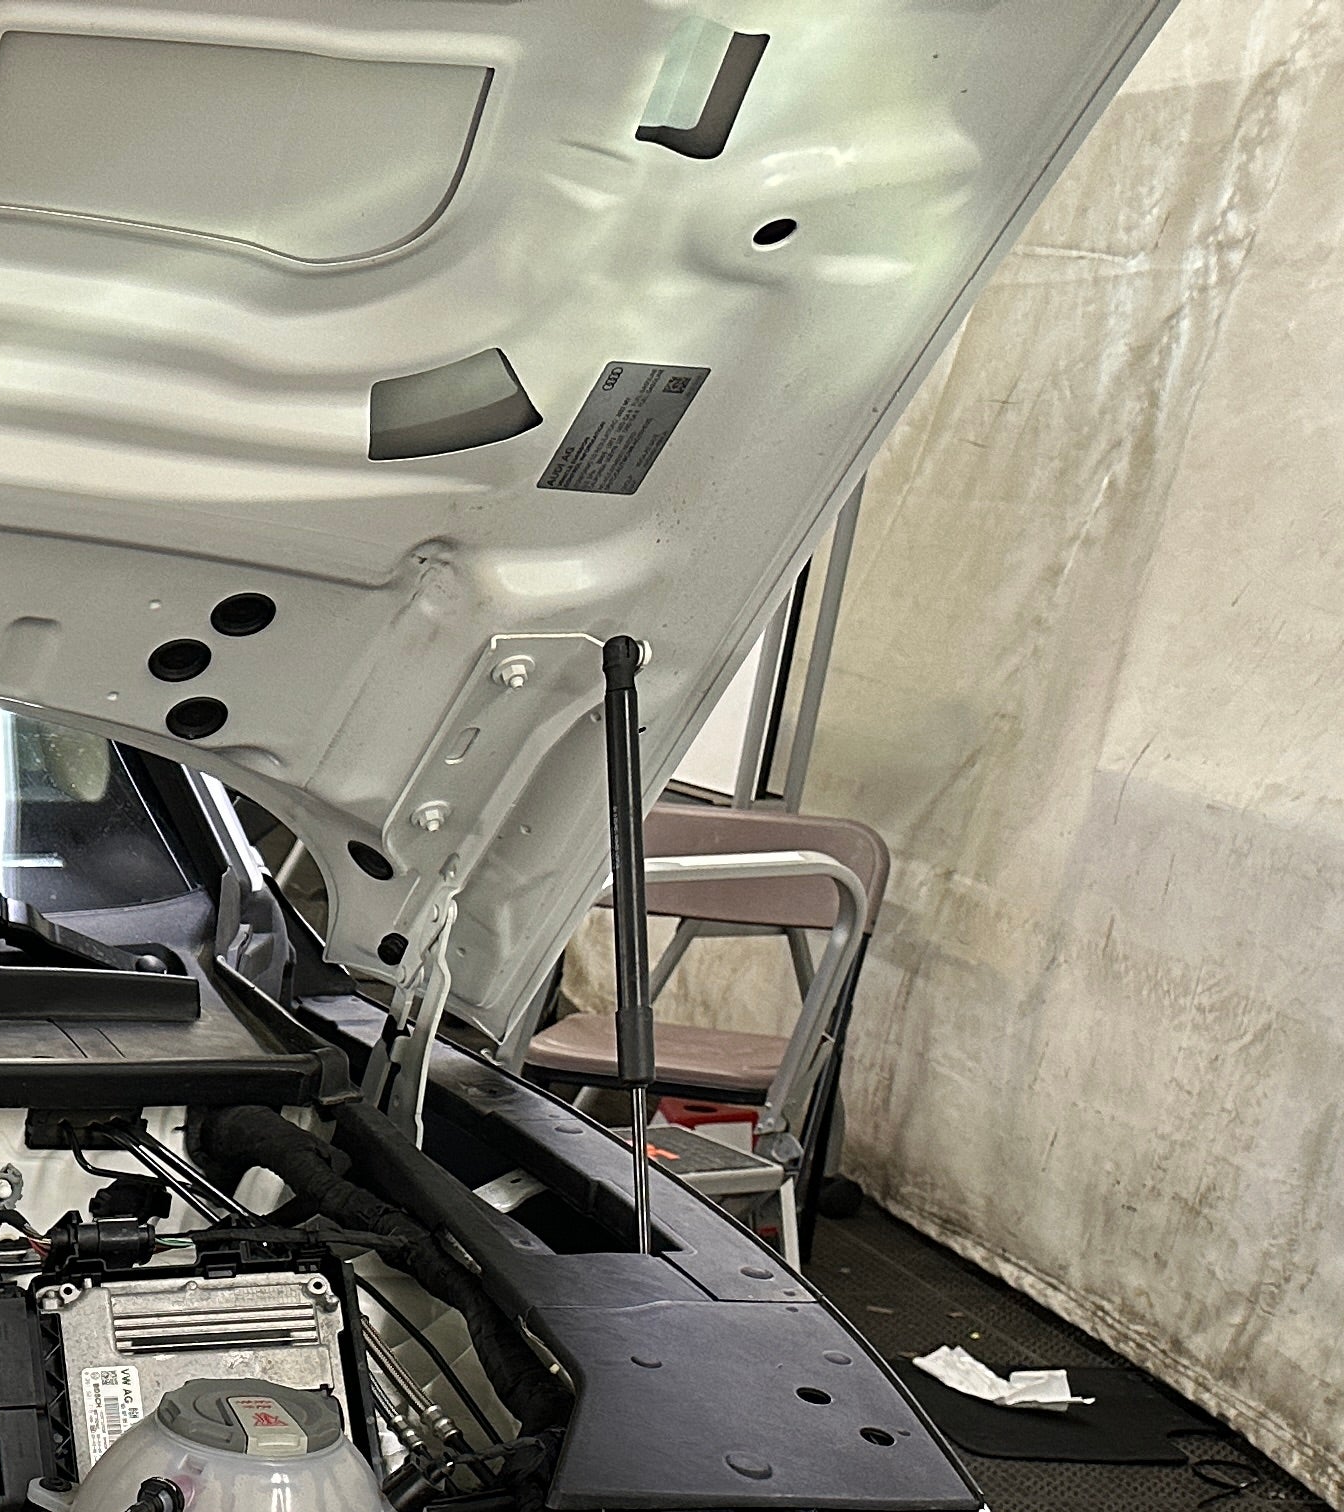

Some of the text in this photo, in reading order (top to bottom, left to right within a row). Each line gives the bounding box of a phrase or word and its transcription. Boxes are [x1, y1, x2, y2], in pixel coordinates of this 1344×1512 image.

[547, 446, 575, 486] AUDI AG
[120, 1368, 132, 1386] VW
[92, 1383, 102, 1408] BOSCH
[122, 1388, 133, 1404] AG
